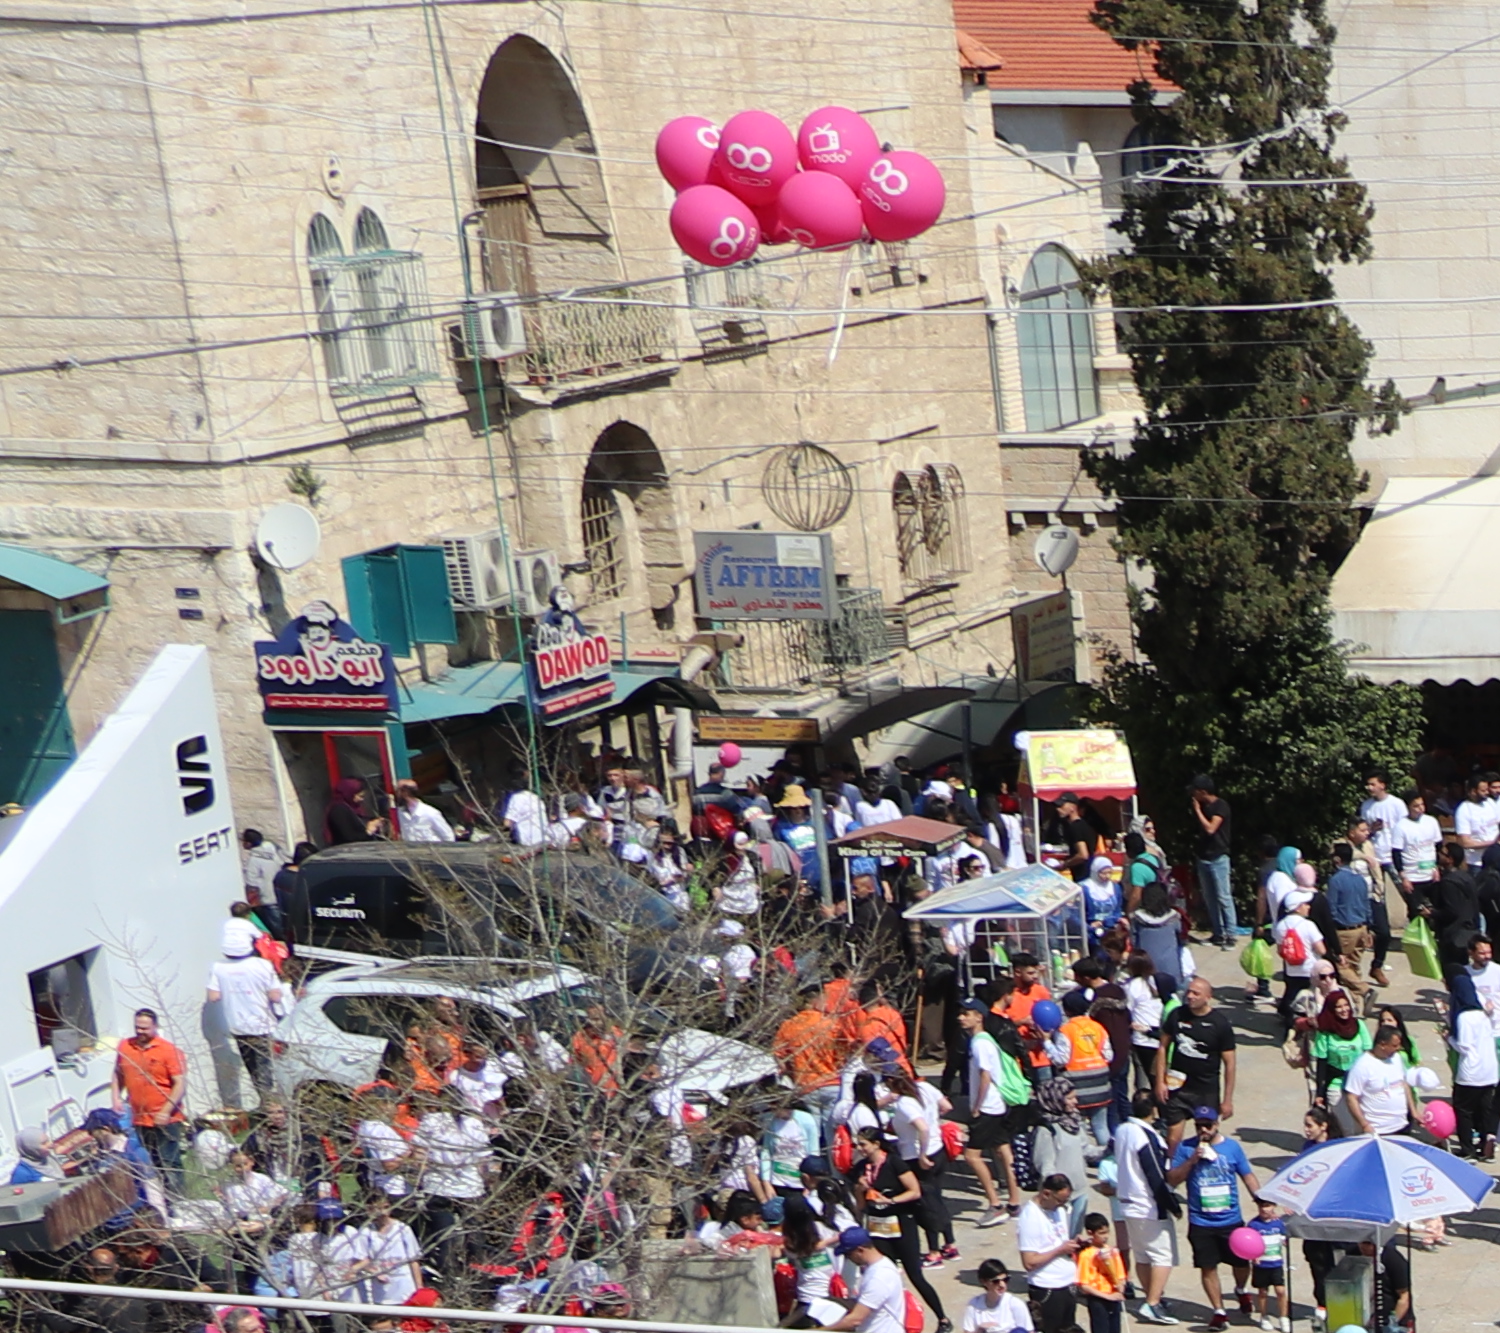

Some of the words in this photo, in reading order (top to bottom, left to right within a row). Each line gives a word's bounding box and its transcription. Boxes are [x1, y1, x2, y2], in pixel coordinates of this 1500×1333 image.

[717, 565, 822, 588] AFTEEM
[538, 635, 610, 686] DAWOD
[178, 825, 232, 866] SEAT
[838, 846, 868, 858] King
[315, 906, 366, 920] SECURITY
